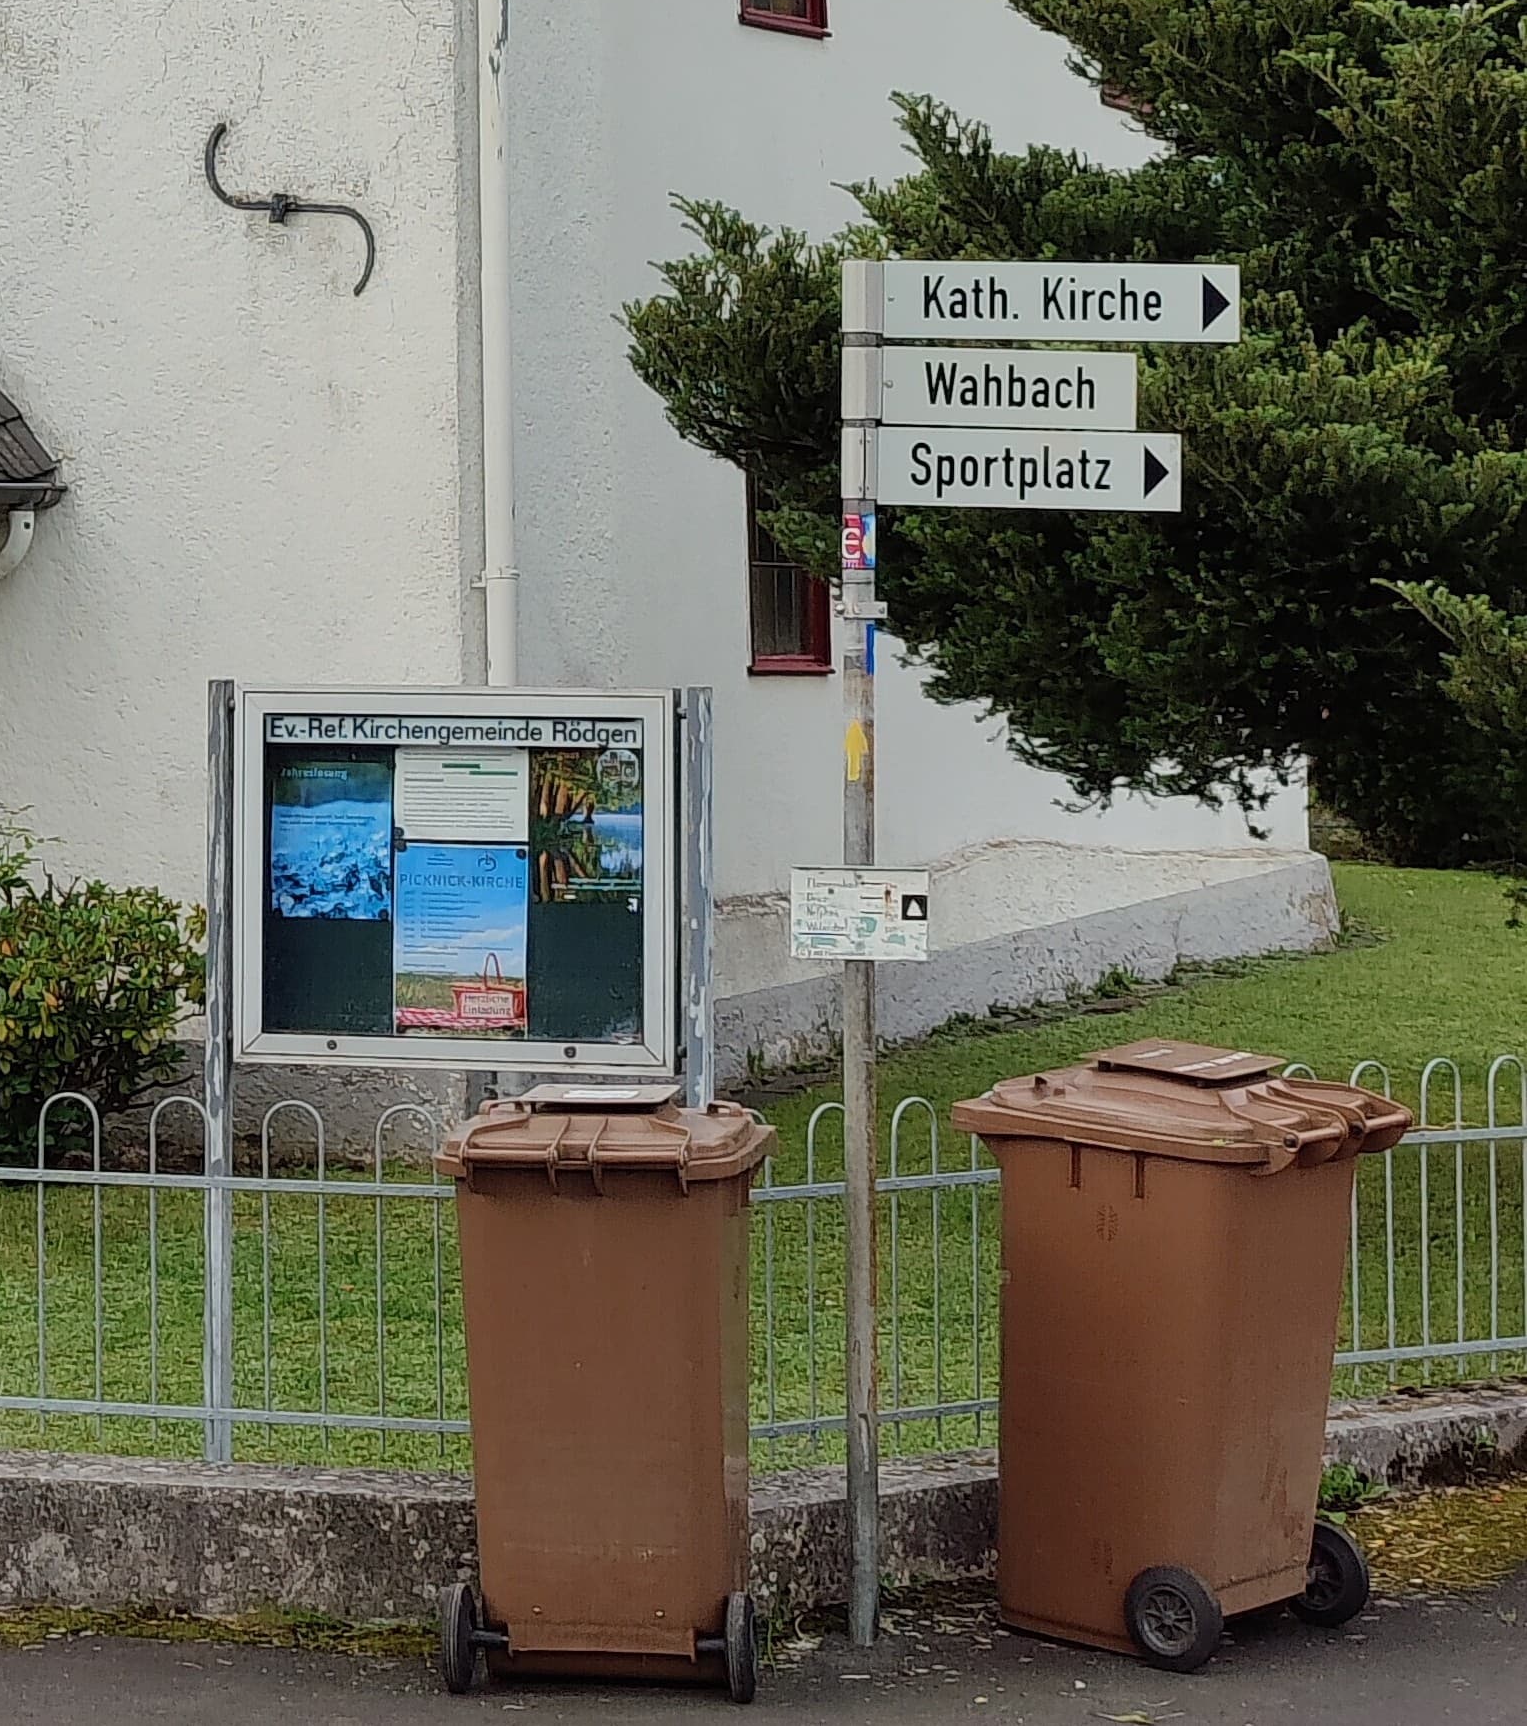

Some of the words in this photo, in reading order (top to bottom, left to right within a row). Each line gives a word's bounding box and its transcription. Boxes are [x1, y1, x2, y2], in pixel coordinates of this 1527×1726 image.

[922, 275, 1020, 321] Kath.
[1042, 276, 1163, 323] Kirche
[924, 361, 1096, 410] Wahbach
[910, 442, 1112, 501] Sportplatz
[269, 718, 348, 739] Ev.-Ref.
[352, 719, 543, 746] Kirchengemeinde
[552, 721, 638, 747] Rödgen
[399, 873, 524, 889] PICKNICK-KIRCHE
